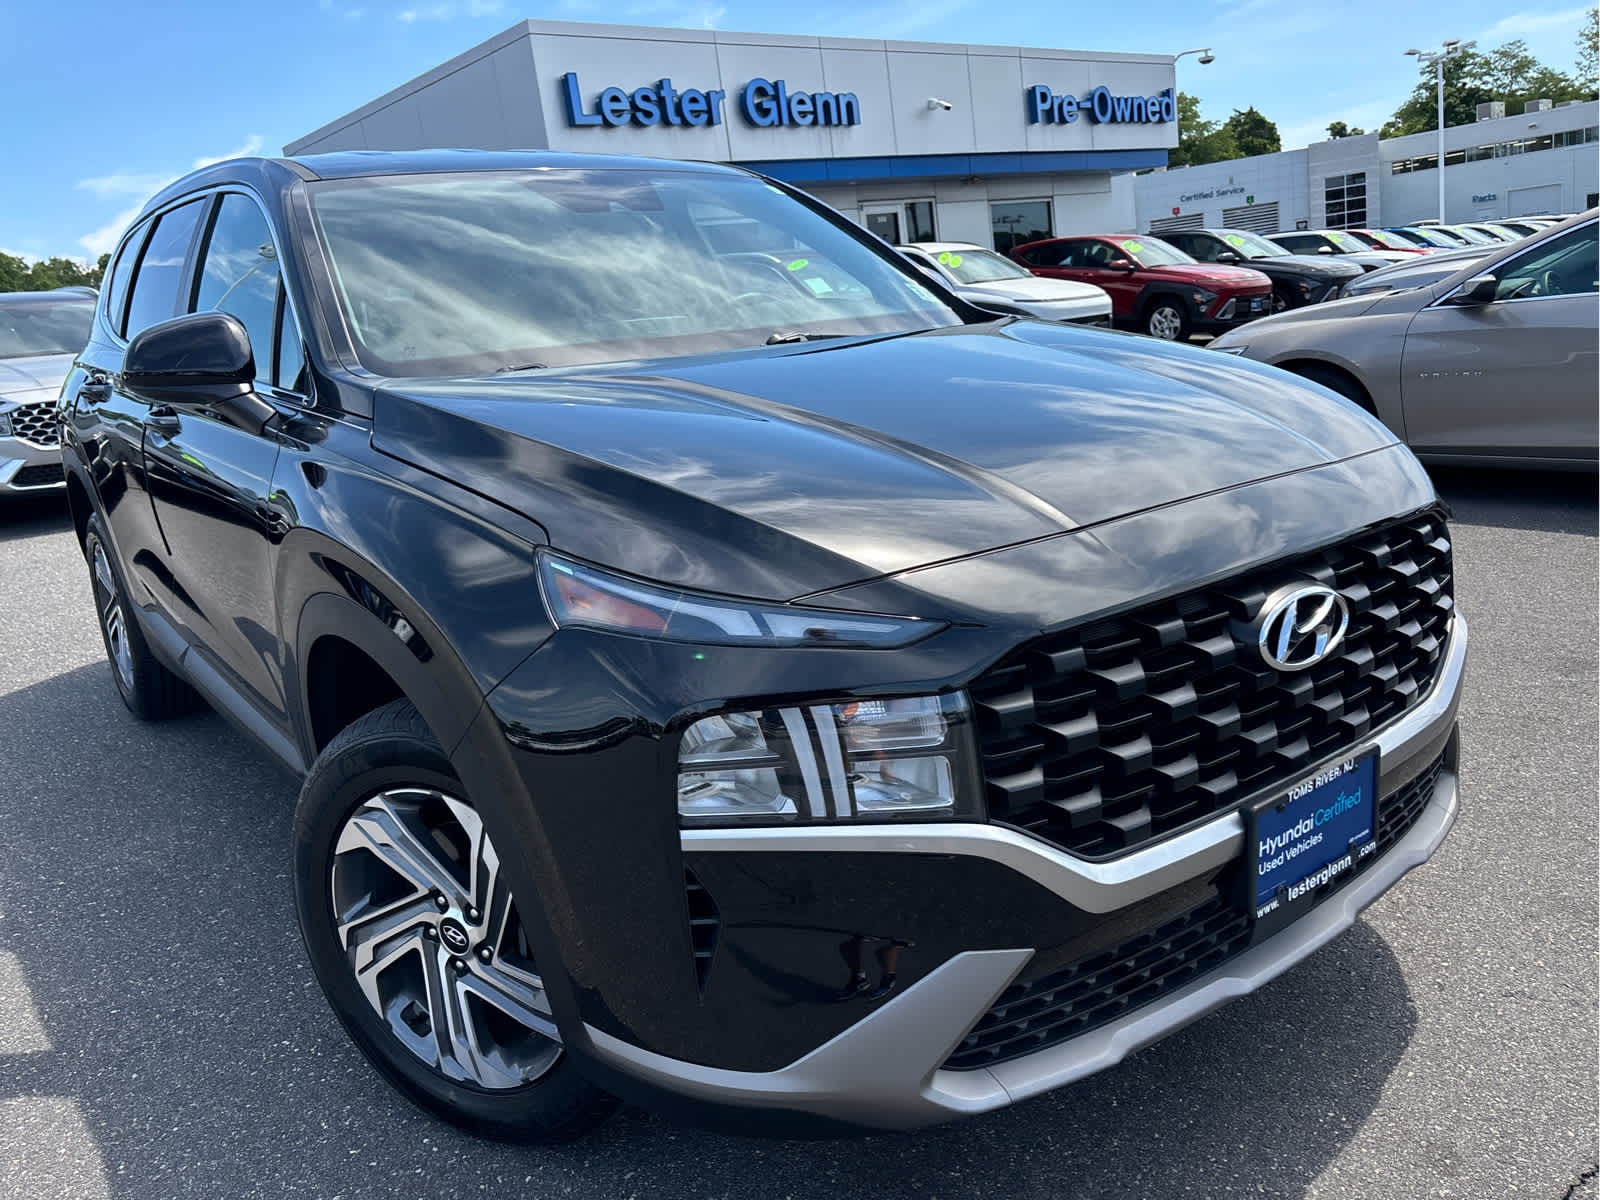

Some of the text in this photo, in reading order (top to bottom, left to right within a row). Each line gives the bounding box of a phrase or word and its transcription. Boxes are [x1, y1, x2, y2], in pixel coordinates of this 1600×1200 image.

[560, 72, 861, 127] Lester Glenn
[1027, 84, 1176, 124] Pre-Owned
[1287, 781, 1314, 803] TOMS
[1258, 787, 1361, 857] Hyundai Certified
[1258, 855, 1284, 876] Used
[1285, 832, 1323, 862] Vehicles
[1287, 854, 1352, 902] lesterglenn
